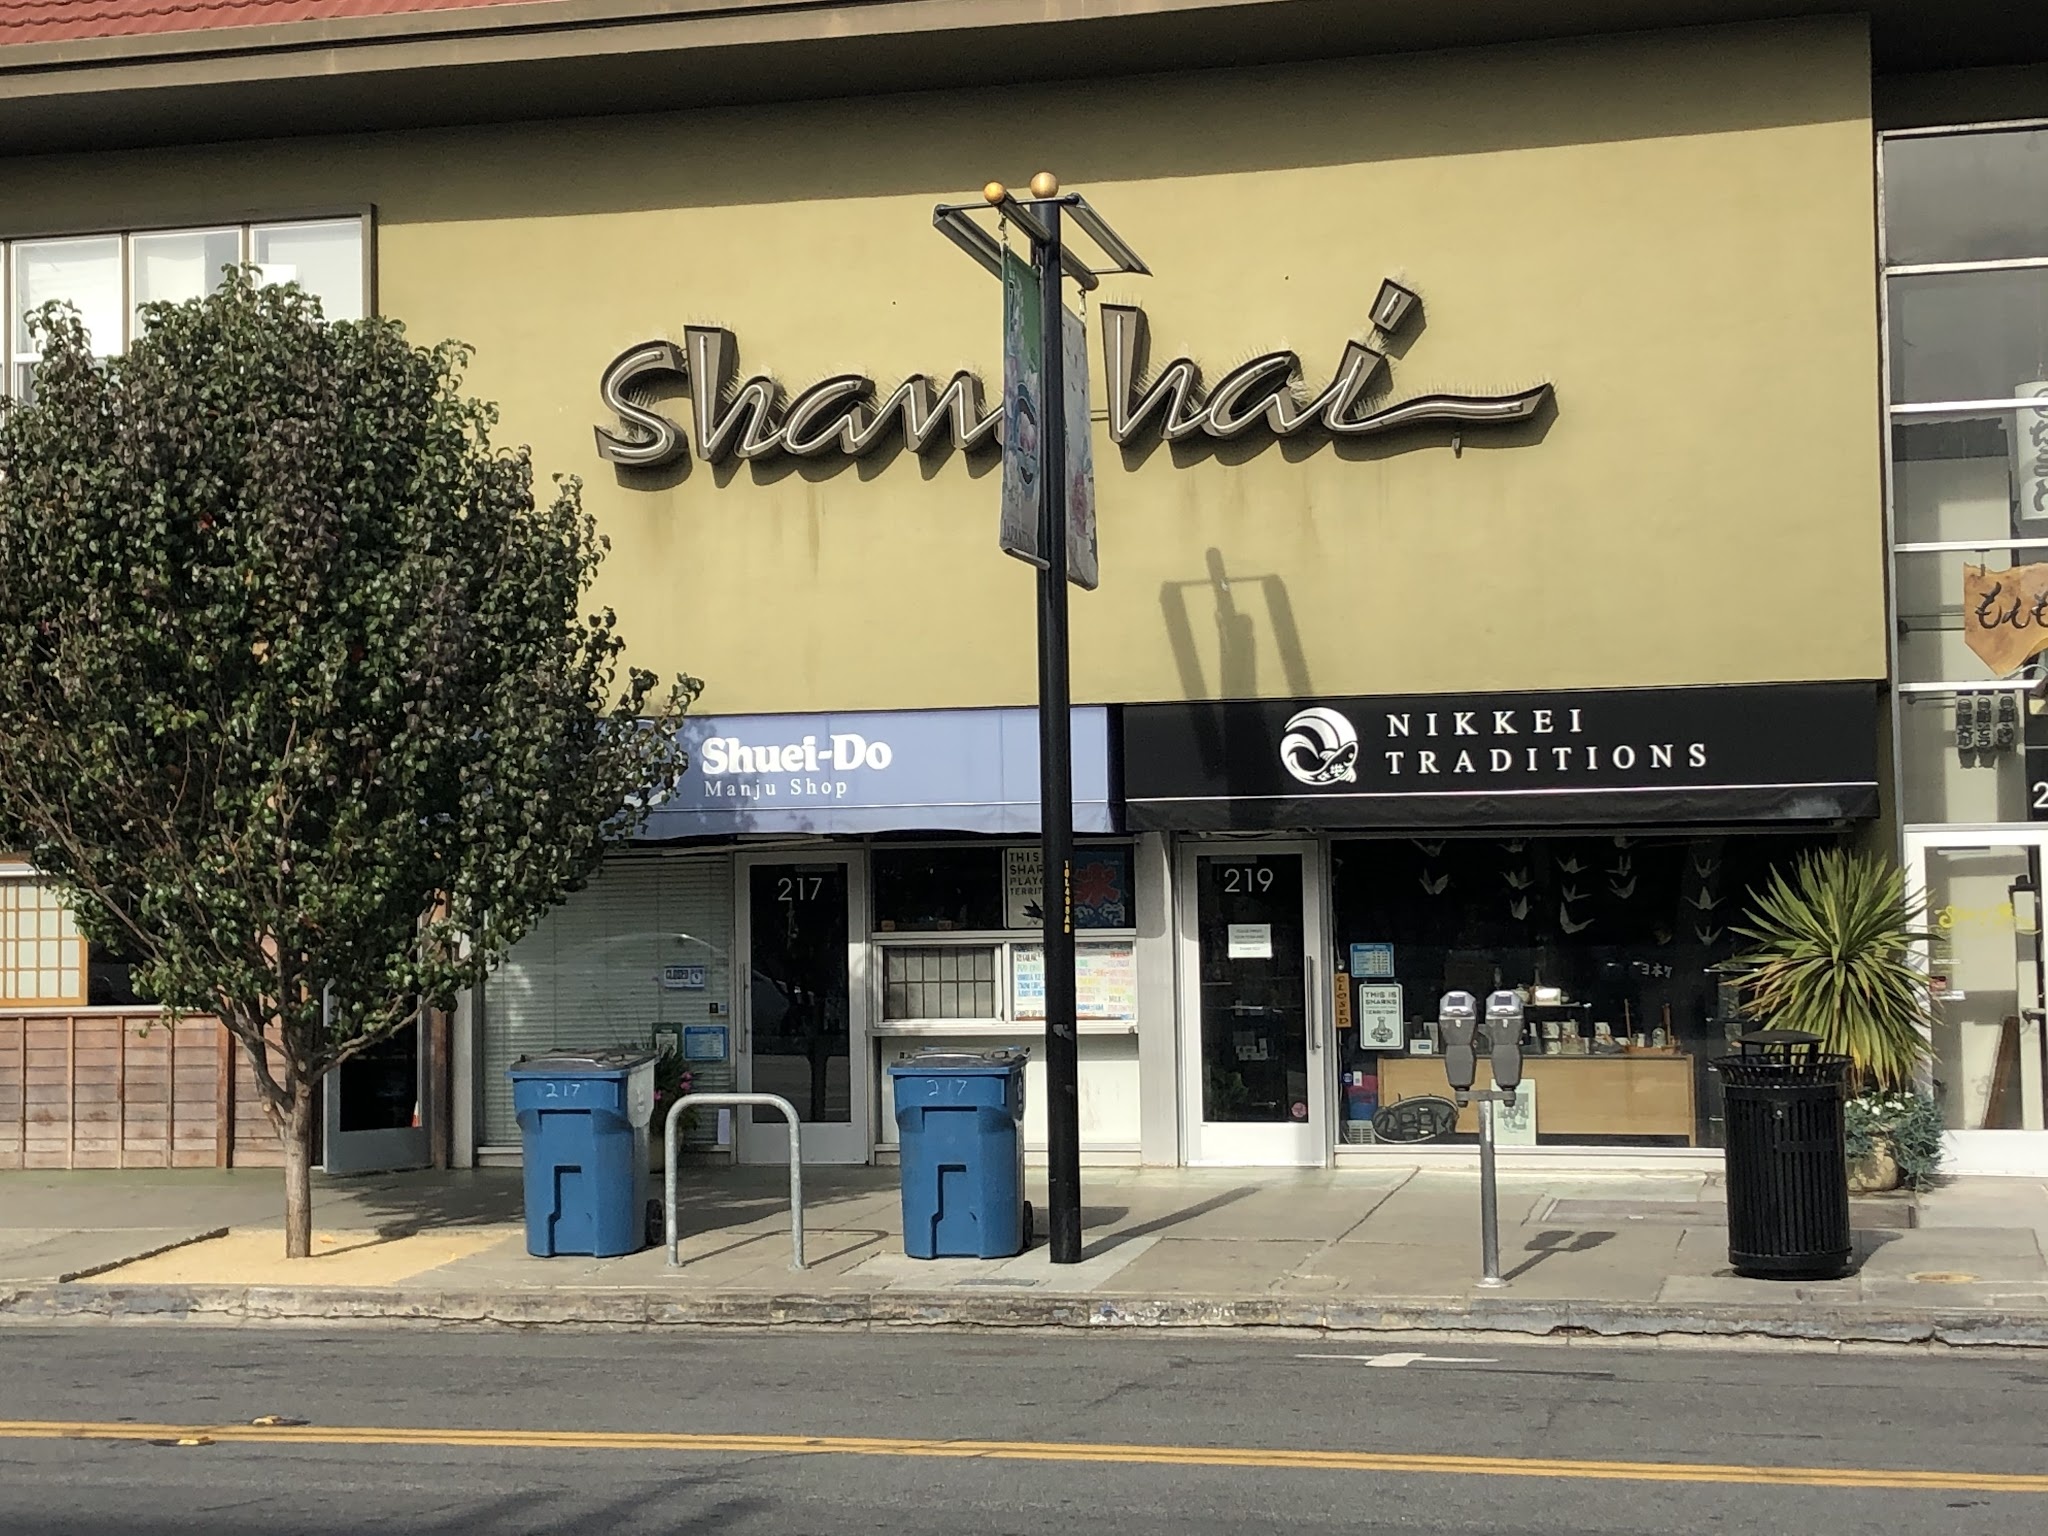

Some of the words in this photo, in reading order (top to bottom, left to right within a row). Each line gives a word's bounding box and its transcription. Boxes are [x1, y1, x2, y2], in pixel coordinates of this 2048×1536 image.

[594, 278, 1554, 466] Shanhai
[1387, 709, 1582, 737] NIKKEI
[702, 733, 892, 774] Shuei-Do
[1385, 744, 1707, 774] TRADITIONS
[704, 780, 776, 800] Manju
[790, 778, 847, 798] Shop
[1009, 852, 1039, 863] THIS
[1009, 864, 1043, 876] SHAR
[1224, 868, 1274, 893] 219
[777, 877, 823, 901] 217
[1010, 887, 1042, 896] TERRIT
[1337, 975, 1349, 1025] CLOSED
[545, 1082, 580, 1098] 217
